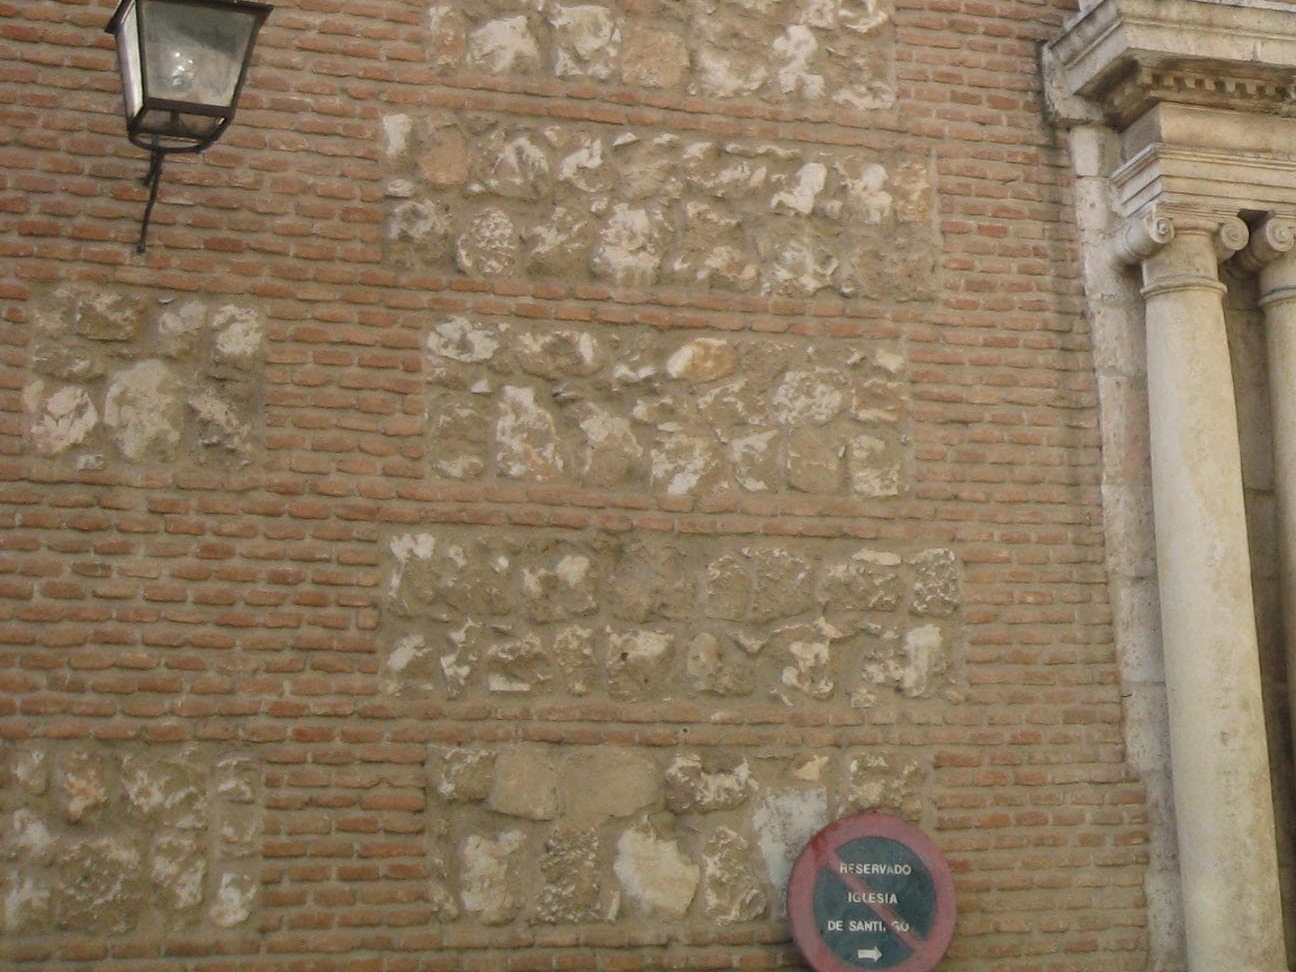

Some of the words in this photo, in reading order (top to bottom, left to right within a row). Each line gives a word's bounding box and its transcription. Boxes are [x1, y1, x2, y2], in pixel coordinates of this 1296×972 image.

[840, 863, 912, 875] RESERVADO
[848, 892, 898, 904] IGLESIA
[827, 920, 844, 931] DE
[849, 920, 910, 932] SANTIGO
